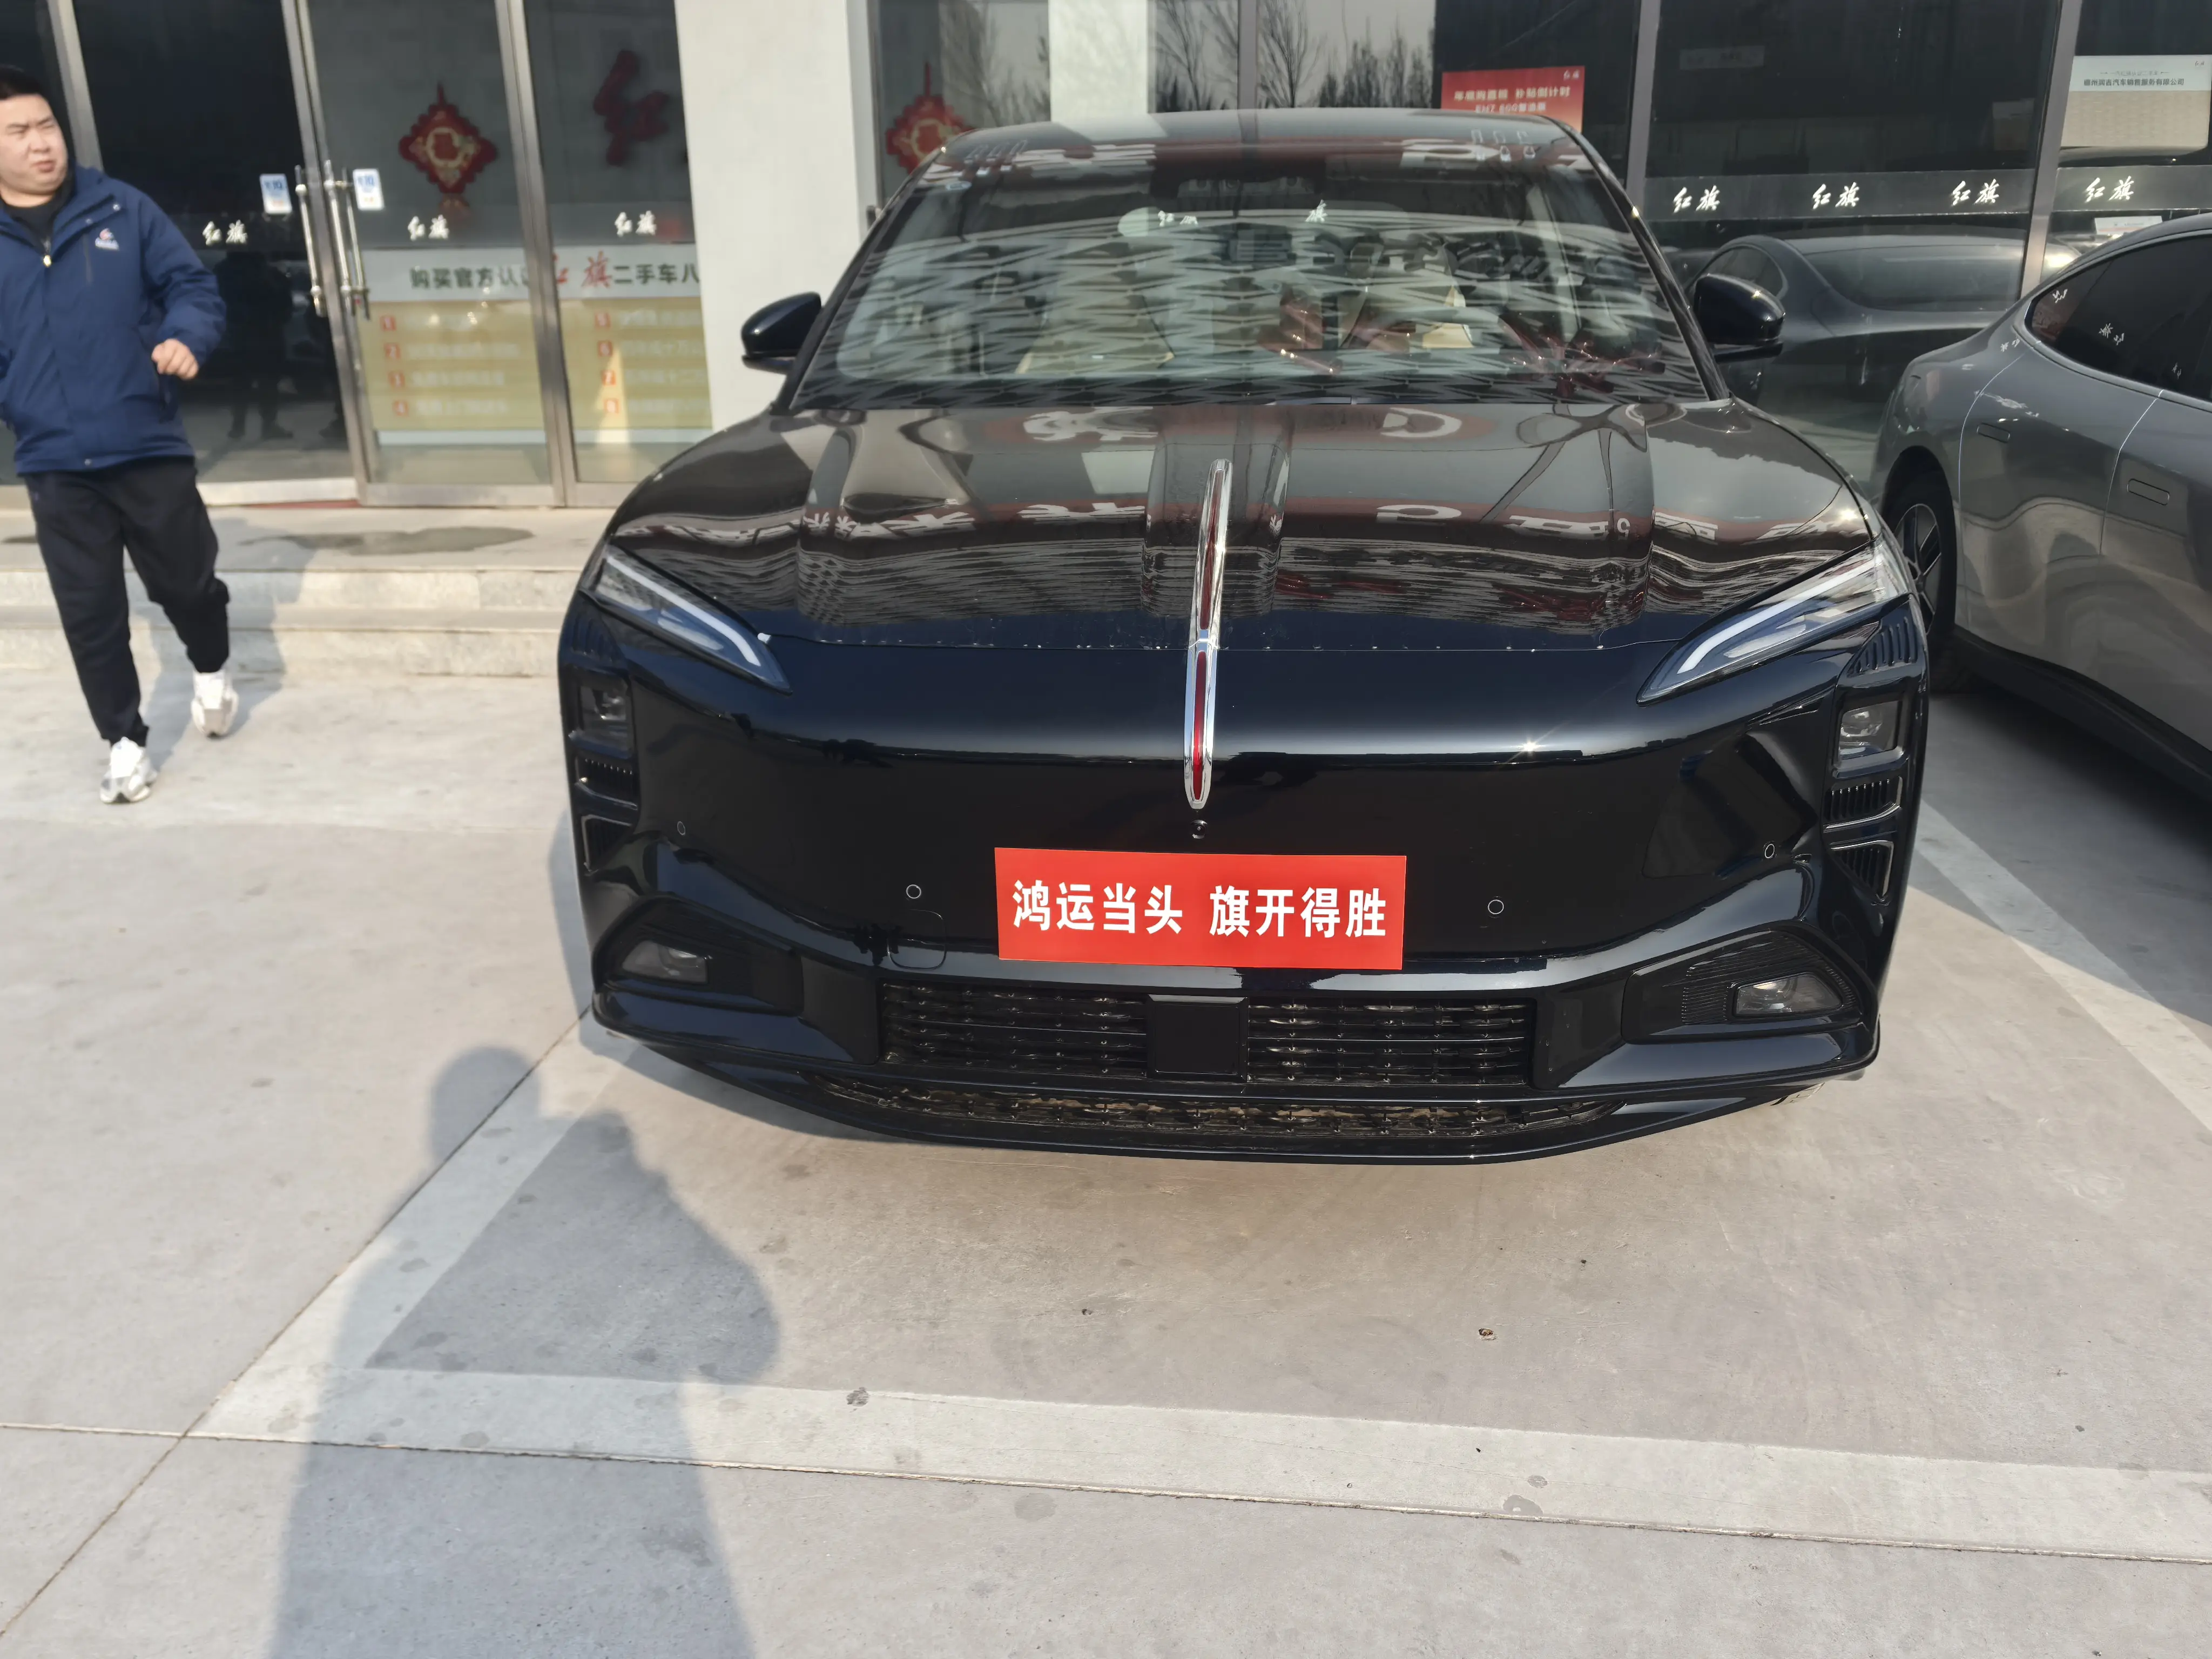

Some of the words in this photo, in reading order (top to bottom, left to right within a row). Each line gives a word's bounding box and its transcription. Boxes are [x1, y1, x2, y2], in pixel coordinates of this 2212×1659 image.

[1673, 185, 1720, 213] 红旗
[1812, 181, 1860, 210] 红旗
[1951, 178, 2000, 206] 红旗
[2082, 175, 2135, 204] 红旗
[1012, 879, 1183, 935] 鸿运当头
[1209, 885, 1387, 939] 旗开得胜
